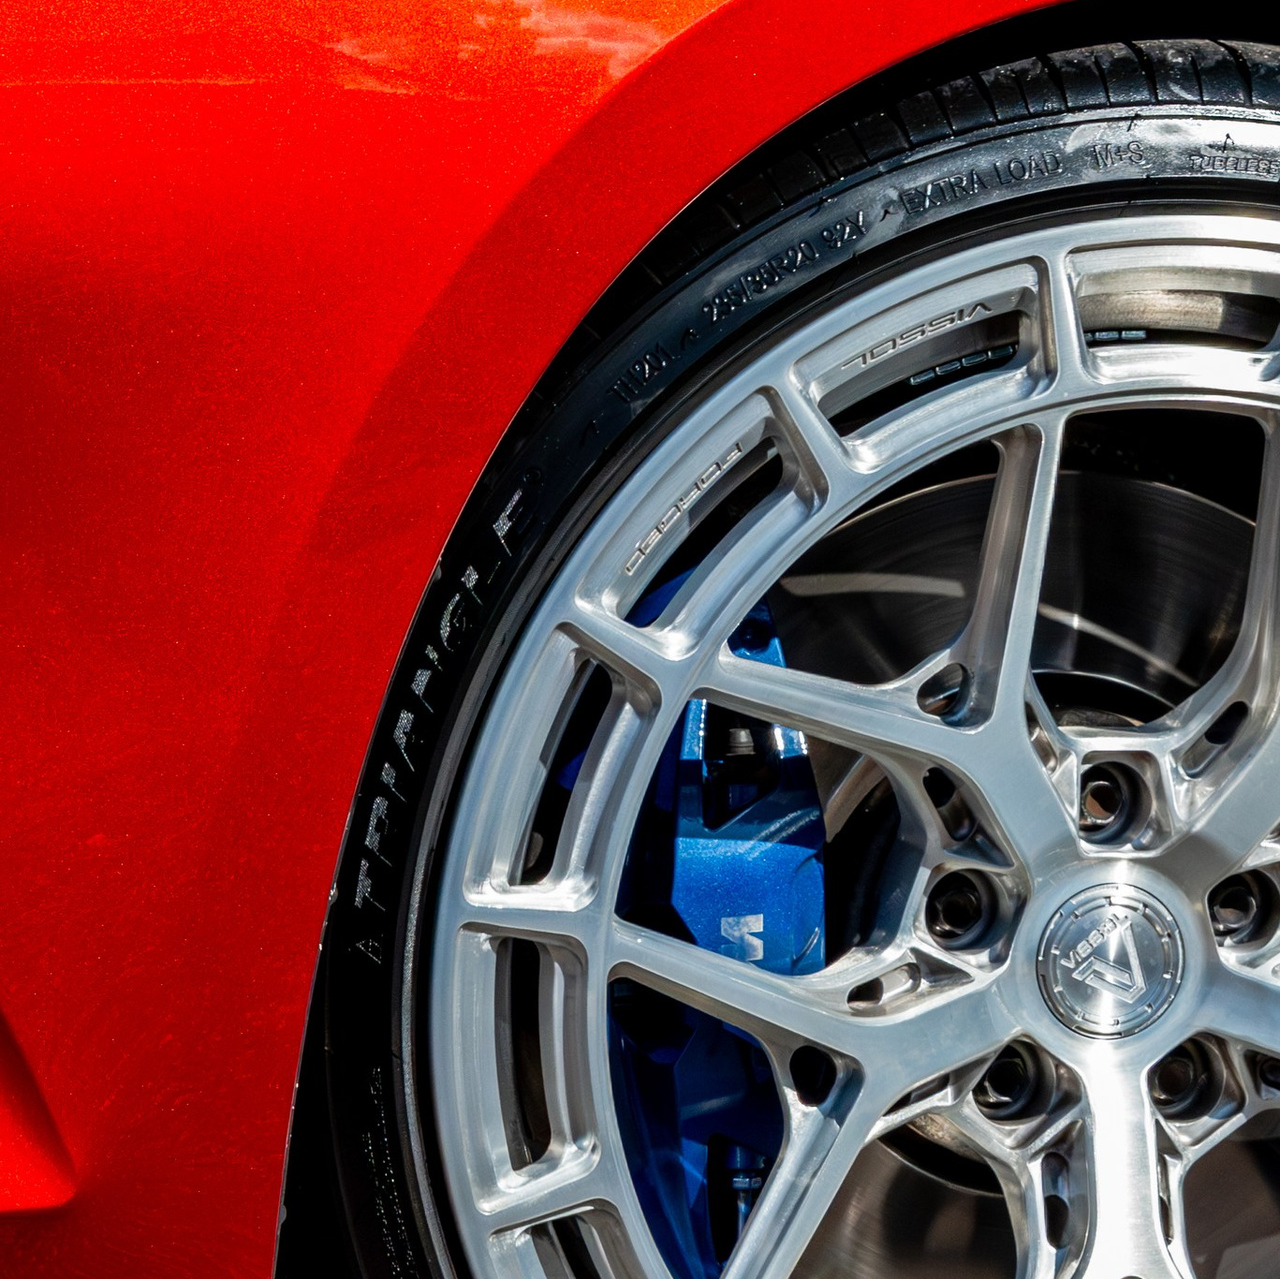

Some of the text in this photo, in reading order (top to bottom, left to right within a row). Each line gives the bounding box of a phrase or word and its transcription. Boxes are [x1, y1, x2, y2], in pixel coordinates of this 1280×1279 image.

[1190, 155, 1280, 175] TUBELESS
[841, 302, 992, 369] VISSOL
[354, 488, 526, 912] TRIANGLE
[611, 345, 672, 404] TH201
[822, 211, 869, 250] 92Y
[901, 169, 989, 215] EXTRA
[996, 150, 1063, 185] LOAD
[1093, 141, 1145, 167] M+S
[625, 442, 743, 576] FORGED
